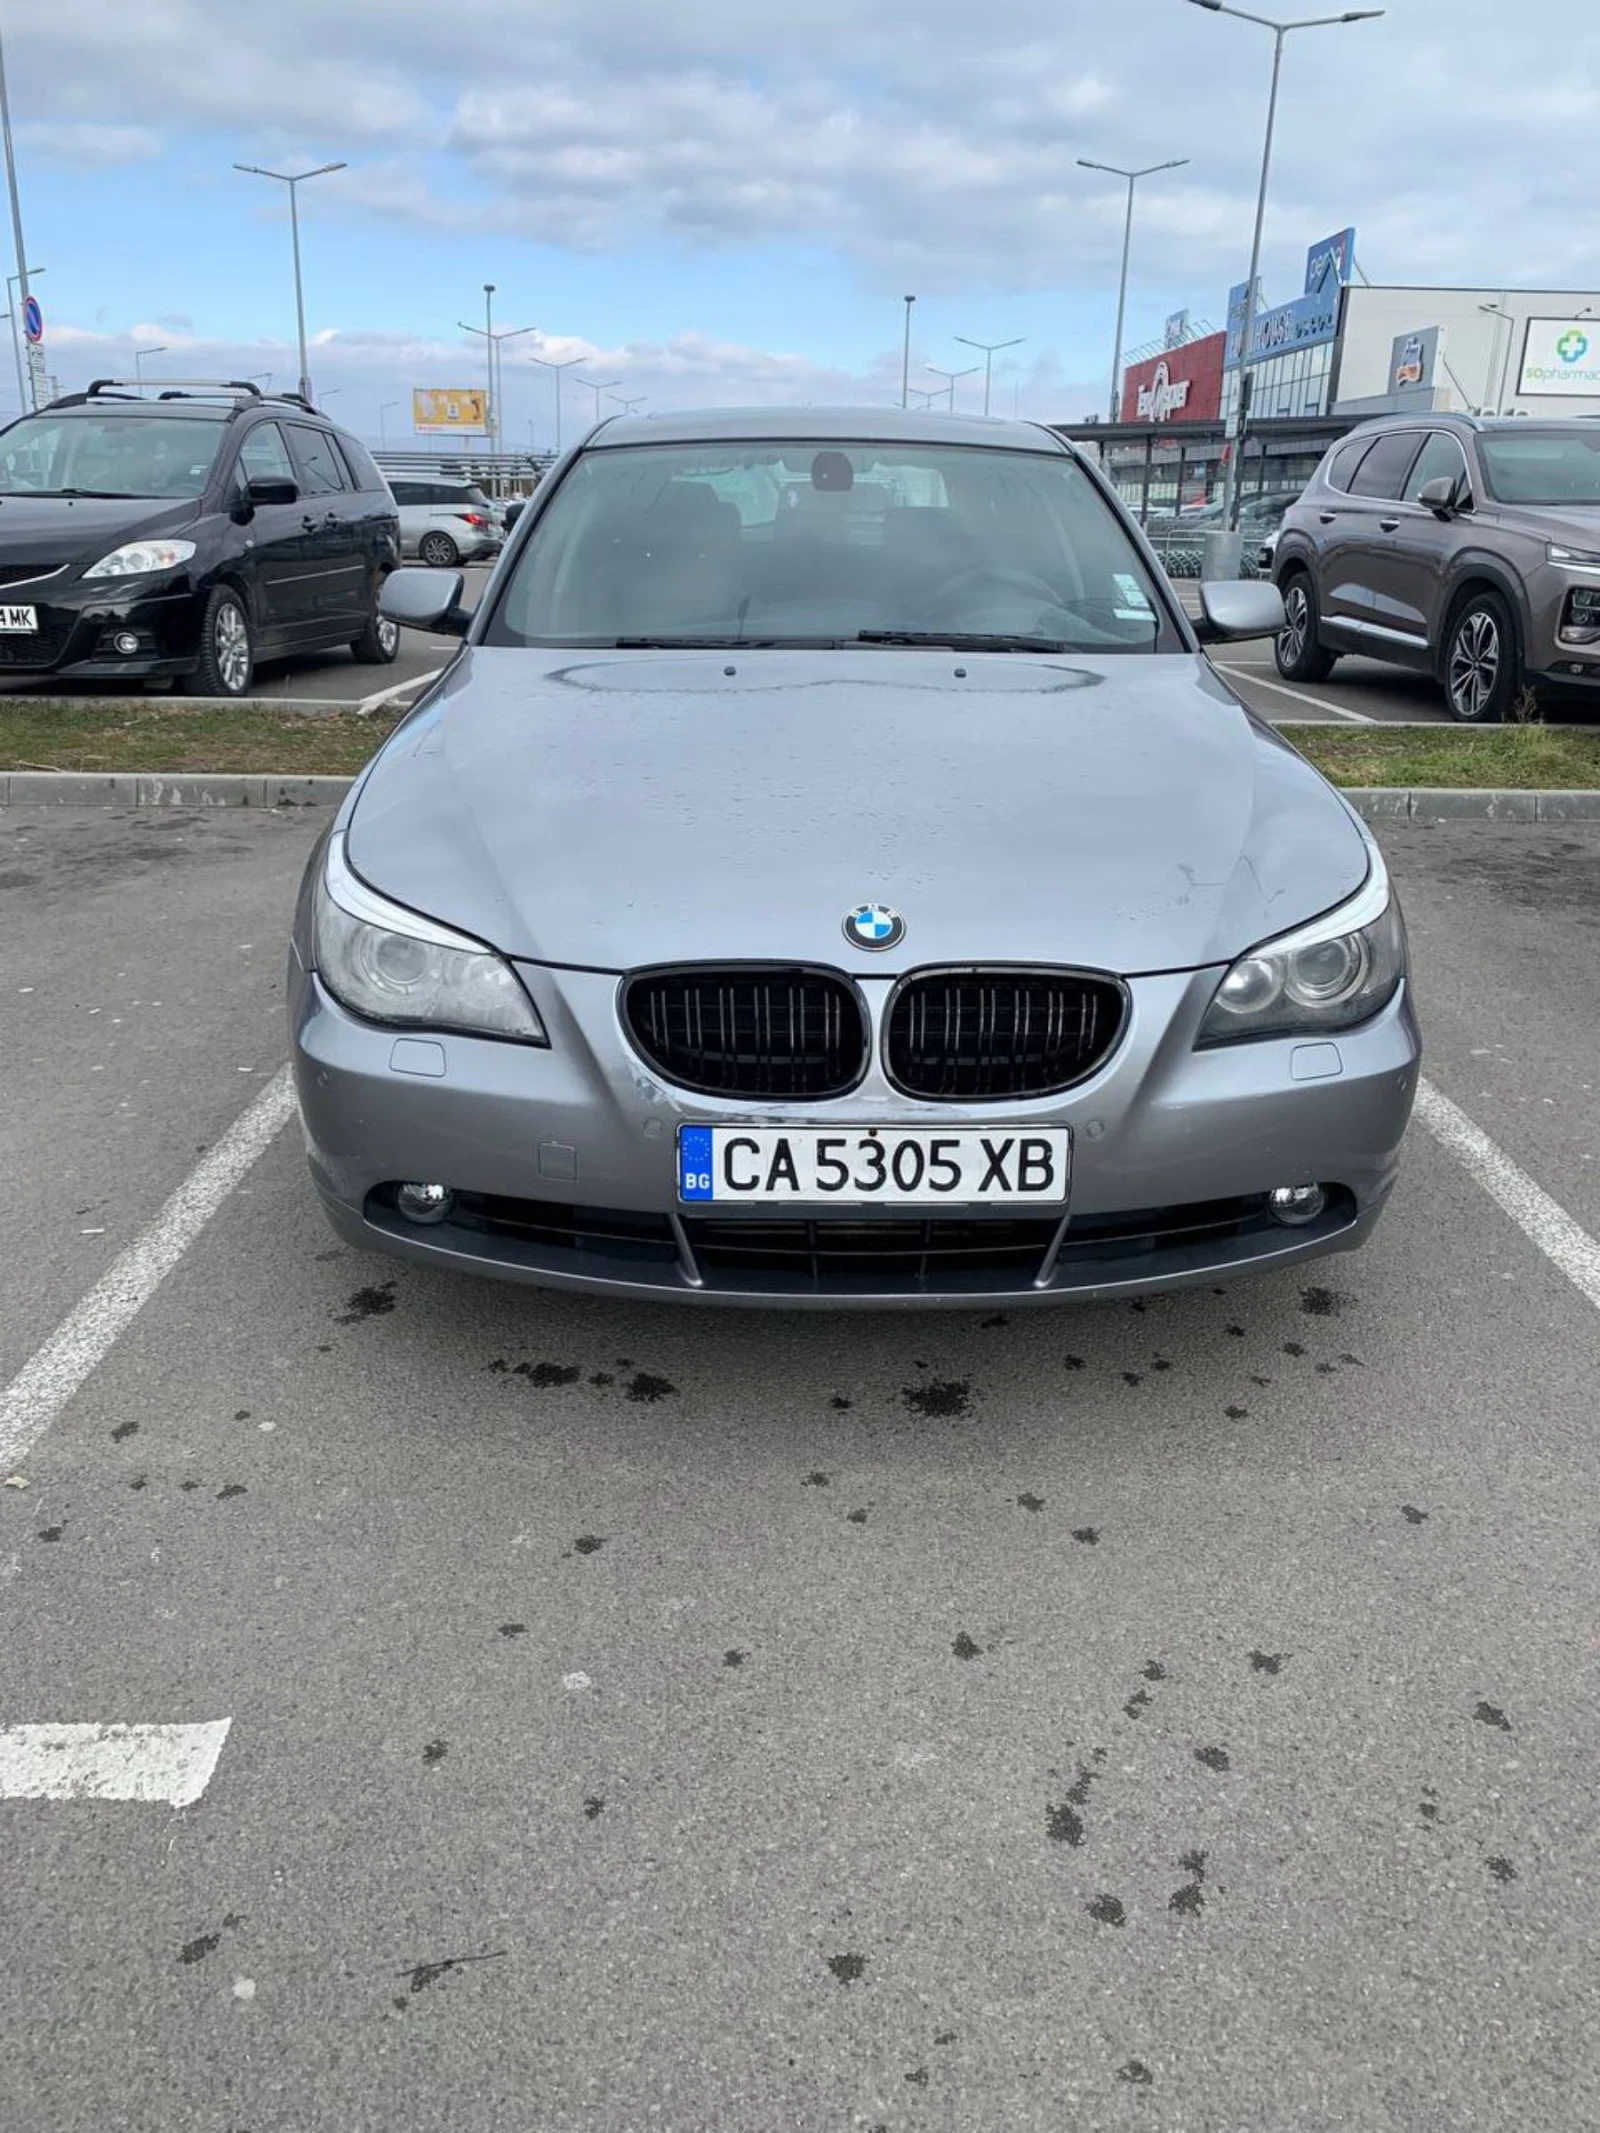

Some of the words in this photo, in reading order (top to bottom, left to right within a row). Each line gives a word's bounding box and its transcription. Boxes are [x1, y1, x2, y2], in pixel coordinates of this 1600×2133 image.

[9, 608, 32, 626] MK
[723, 1138, 800, 1191] CA
[816, 1139, 962, 1191] 5305
[978, 1139, 1055, 1191] XB
[685, 1173, 710, 1189] BG
